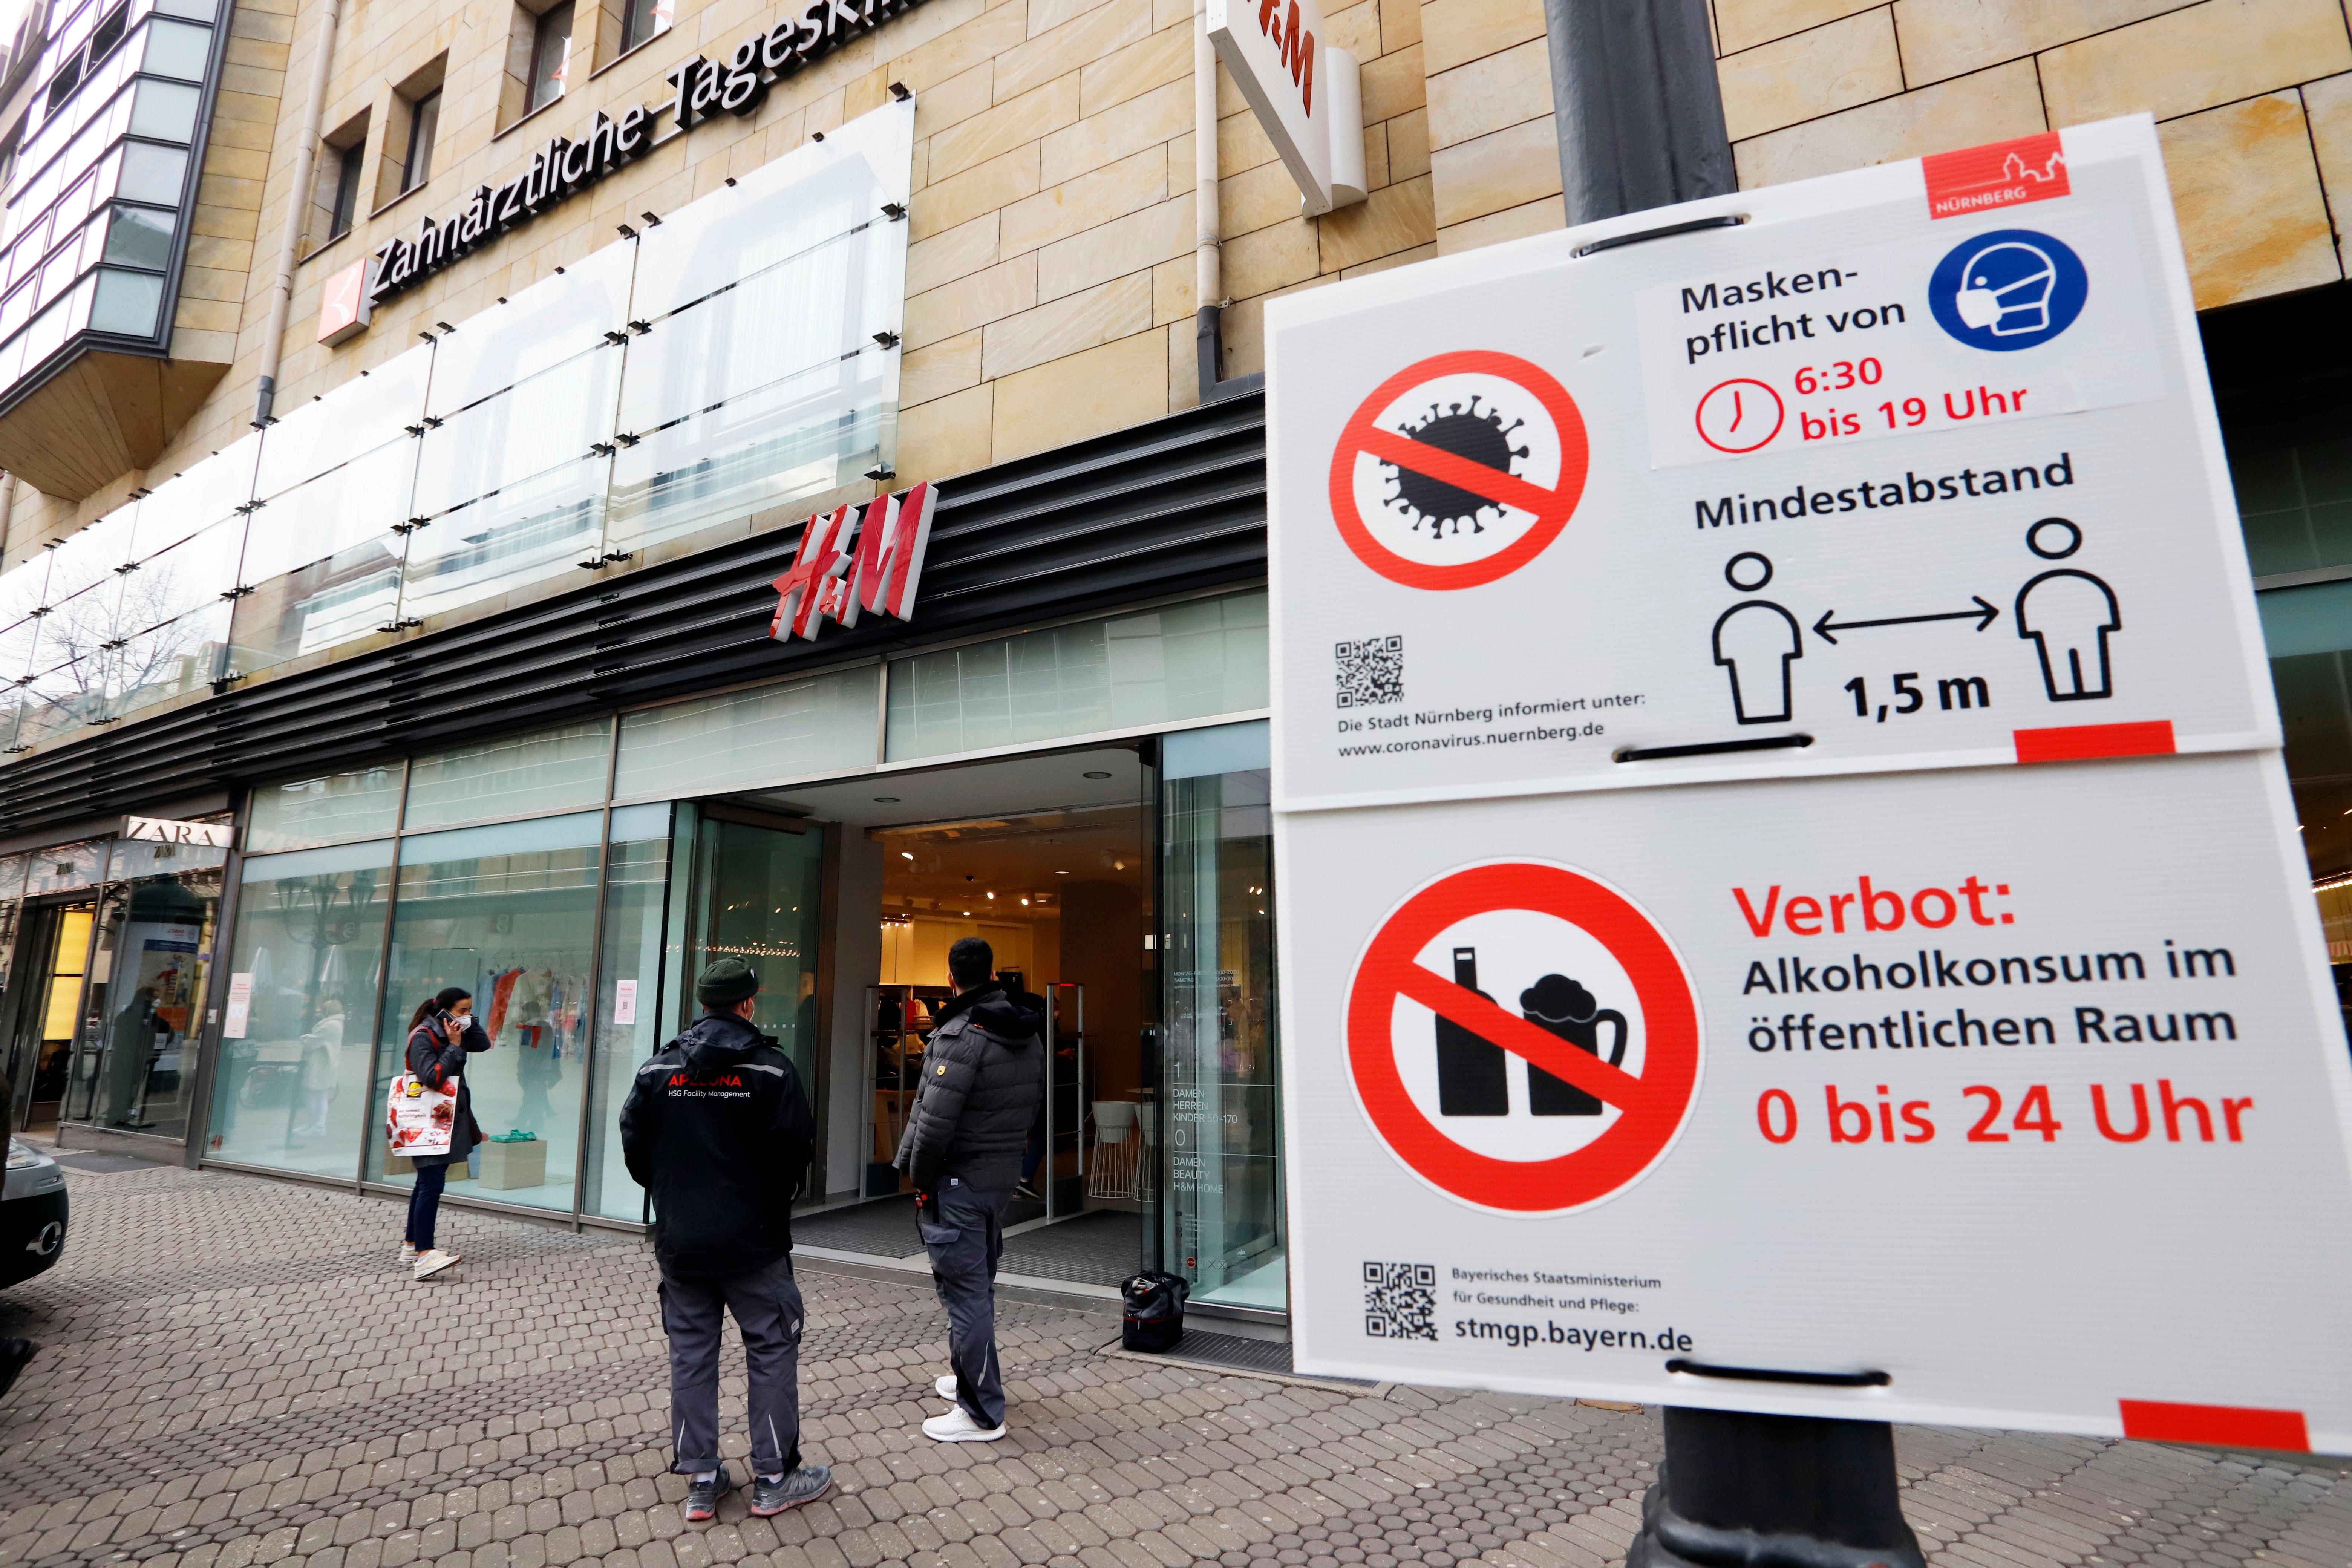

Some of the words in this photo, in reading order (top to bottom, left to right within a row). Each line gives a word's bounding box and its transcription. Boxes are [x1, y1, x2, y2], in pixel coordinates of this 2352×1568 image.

[369, 104, 645, 299] Zahnärztliche
[1936, 187, 2026, 213] NÜRNBERG
[1682, 268, 1859, 314] Masken-
[1687, 312, 1815, 364] pflicht
[1826, 303, 1905, 333] von
[1795, 357, 1883, 395] 6:30
[1800, 407, 1861, 441] bis
[1877, 397, 1927, 429] 19
[1943, 385, 2028, 421] Uhr
[1695, 452, 2073, 530] Mindestabstand
[769, 481, 929, 639] H&M
[1338, 719, 1362, 732] Die
[1368, 715, 1409, 730] Stadt
[1415, 706, 1493, 726] Nürnberg
[1499, 697, 1586, 716] informiert
[1592, 694, 1646, 709] unter:
[1844, 672, 1923, 723] 1,5
[1938, 676, 1990, 711] m
[1338, 722, 1604, 757] www.coronavirus.nuernberg.de
[129, 821, 215, 846] ZARA
[1731, 875, 2015, 938] Verbot:
[1743, 949, 2145, 995] Alkoholkonsum
[2165, 940, 2236, 978] im
[1749, 1008, 2055, 1053] öffentlichen
[2075, 1007, 2237, 1044] Raum
[1174, 1061, 1180, 1078] 1
[1173, 1089, 1205, 1098] DAMEN
[1173, 1101, 1208, 1110] HERREN
[1173, 1113, 1205, 1122] KINDER
[1207, 1114, 1238, 1124] 50-170
[1756, 1088, 1798, 1145] 0
[1824, 1084, 1936, 1144] bis
[1962, 1084, 2063, 1143] 24
[2089, 1078, 2254, 1144] Uhr
[1175, 1129, 1185, 1146] 0
[1173, 1170, 1210, 1180] BEAUTY
[1174, 1157, 1205, 1167] DAMEN
[1174, 1182, 1194, 1191] H&M
[1198, 1184, 1223, 1194] HOME
[1452, 1268, 1529, 1283] Bayerisches
[1534, 1271, 1662, 1288] Staatsministerium
[1453, 1291, 1472, 1303] für
[1477, 1292, 1555, 1308] Gesundheit
[1559, 1297, 1585, 1309] und
[1590, 1298, 1639, 1314] Pflege:
[1455, 1318, 1693, 1352] stmgp.bayern.de
